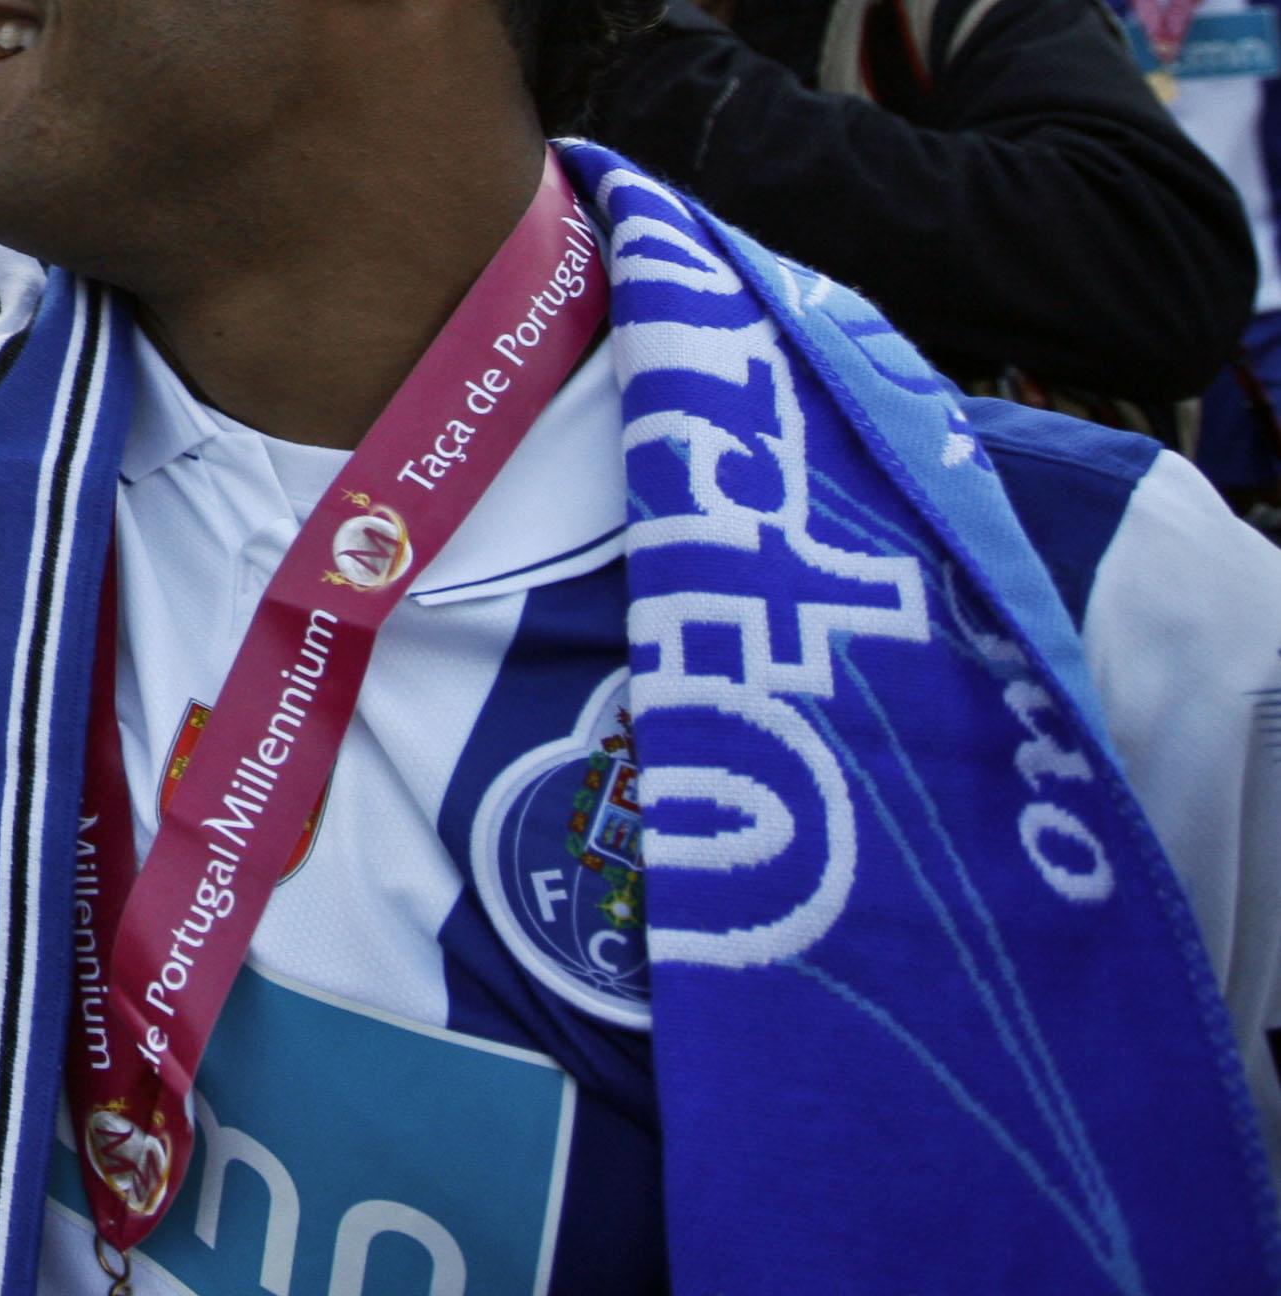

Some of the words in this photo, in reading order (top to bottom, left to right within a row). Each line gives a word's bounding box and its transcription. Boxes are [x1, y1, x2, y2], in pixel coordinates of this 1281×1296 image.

[397, 418, 476, 490] Taça
[465, 368, 511, 414] de
[493, 235, 592, 366] Portugal
[145, 844, 241, 1016] Portugal
[201, 608, 339, 848] Millennium
